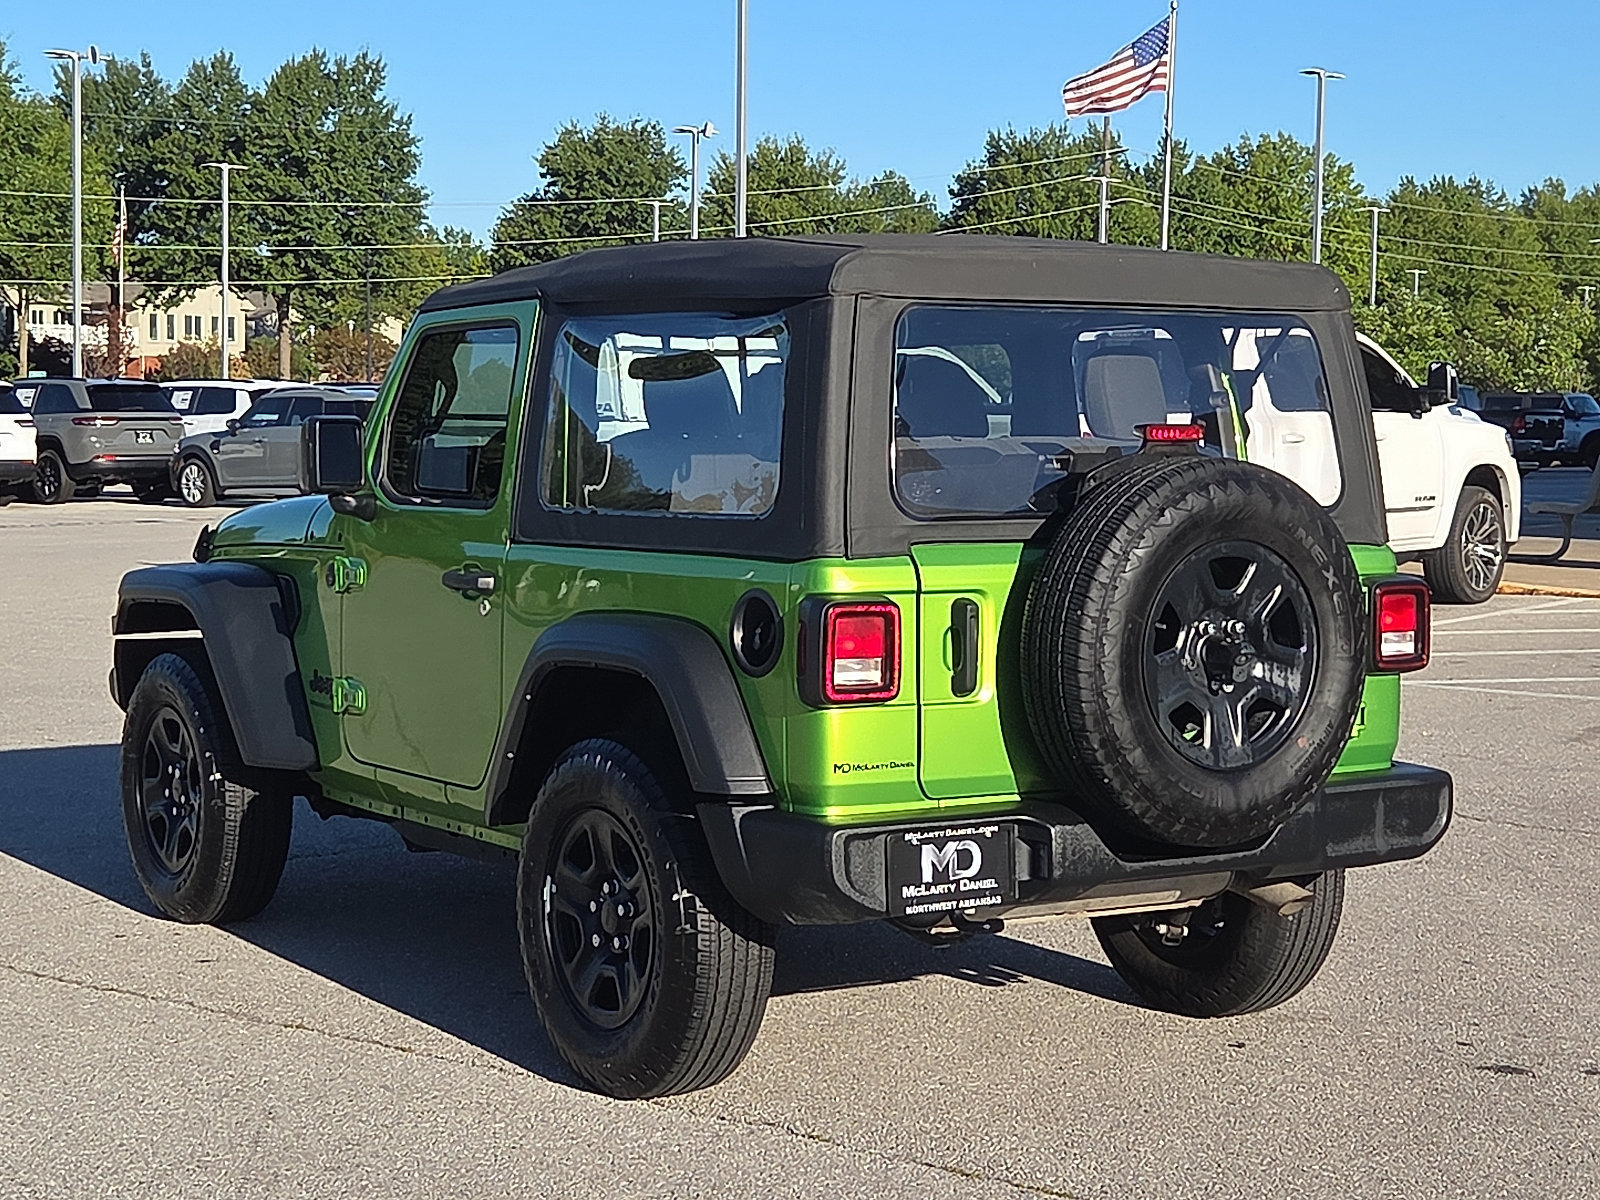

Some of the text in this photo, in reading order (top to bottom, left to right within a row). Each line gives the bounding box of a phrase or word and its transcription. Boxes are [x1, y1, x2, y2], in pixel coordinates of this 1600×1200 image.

[921, 839, 982, 884] MD
[959, 878, 999, 891] DANIEL
[905, 895, 1002, 915] NORTHWEST ARKANSAS
